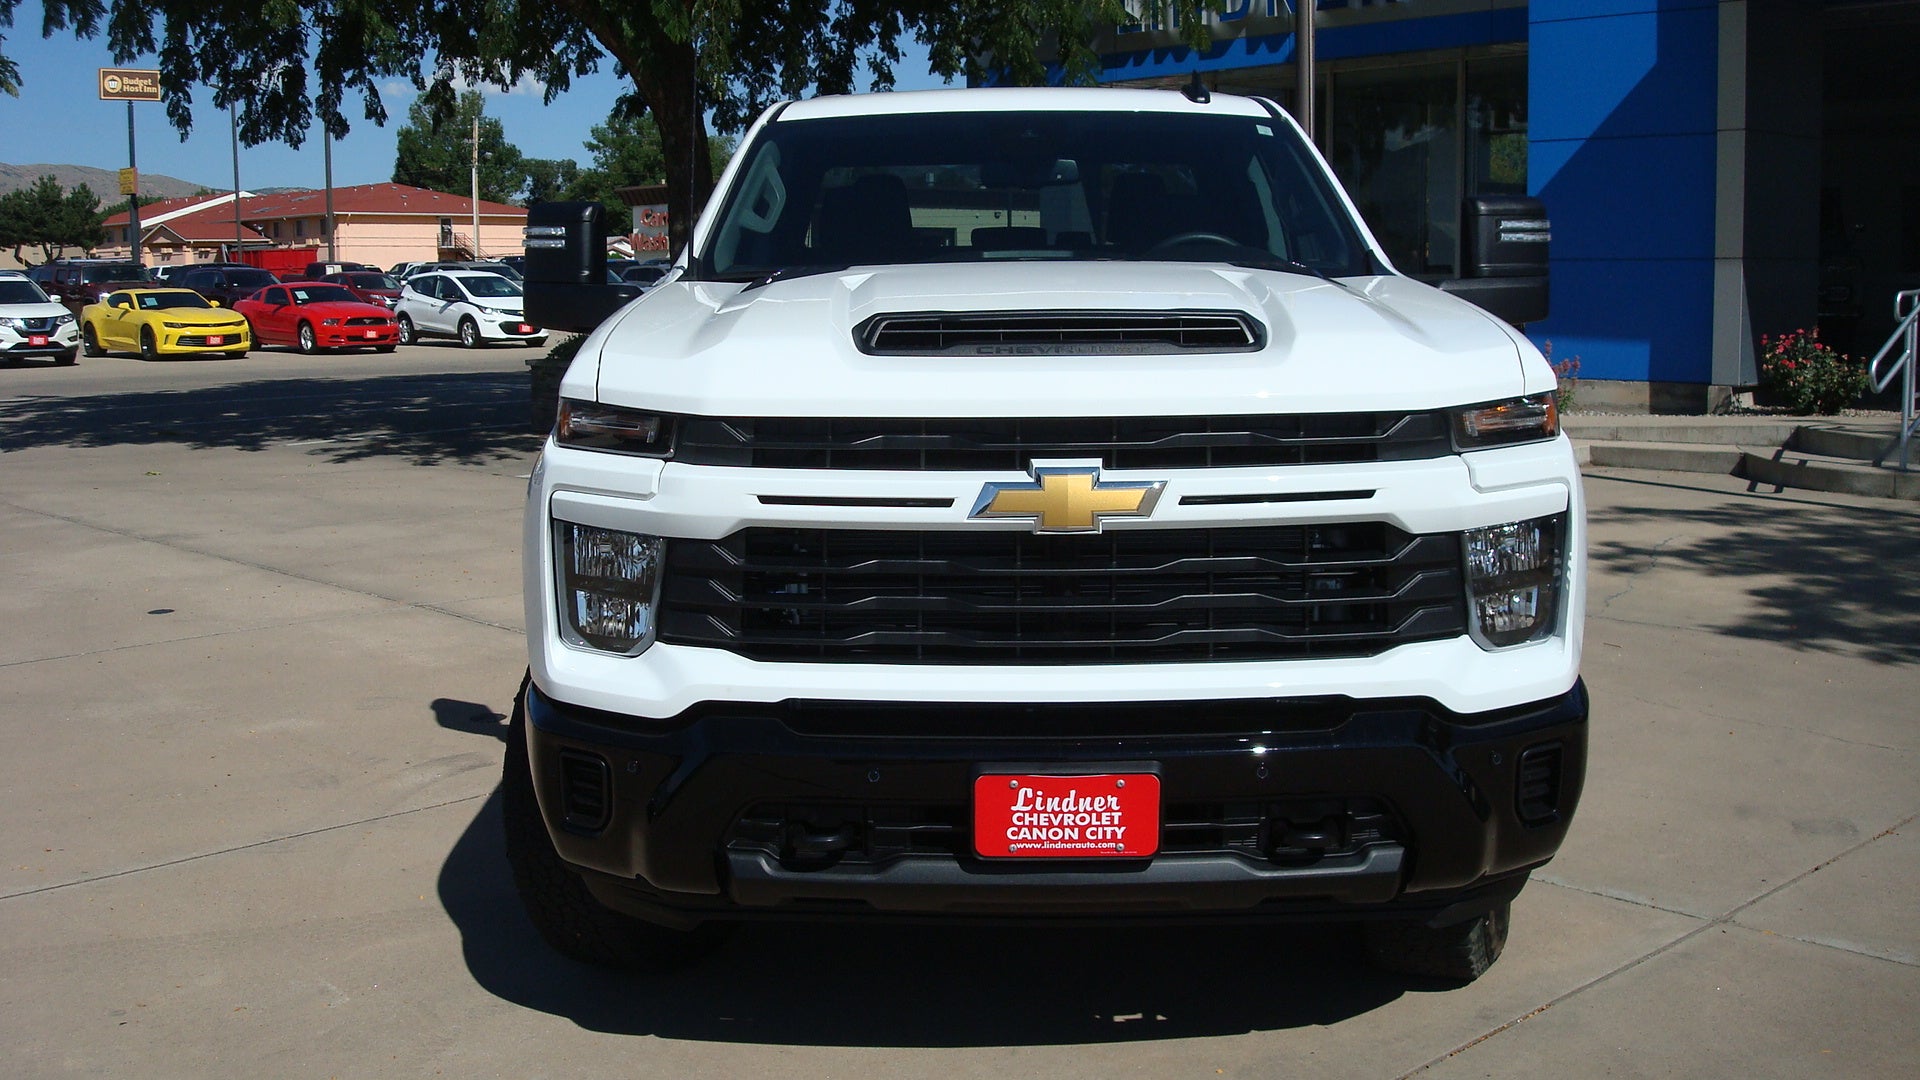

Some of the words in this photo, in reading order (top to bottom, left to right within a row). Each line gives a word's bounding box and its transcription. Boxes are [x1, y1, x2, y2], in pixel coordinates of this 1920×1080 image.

[122, 76, 152, 87] Budget
[122, 84, 143, 93] Host
[143, 85, 158, 93] Inn
[640, 208, 669, 227] Car
[628, 232, 669, 251] Wash
[976, 344, 1152, 355] CHEVR
[1010, 787, 1121, 812] Lindner
[1011, 812, 1123, 826] CHEVROLET
[1006, 826, 1079, 840] CANON
[1085, 826, 1127, 840] CITY
[1016, 841, 1116, 849] www.lindnerauto.com
